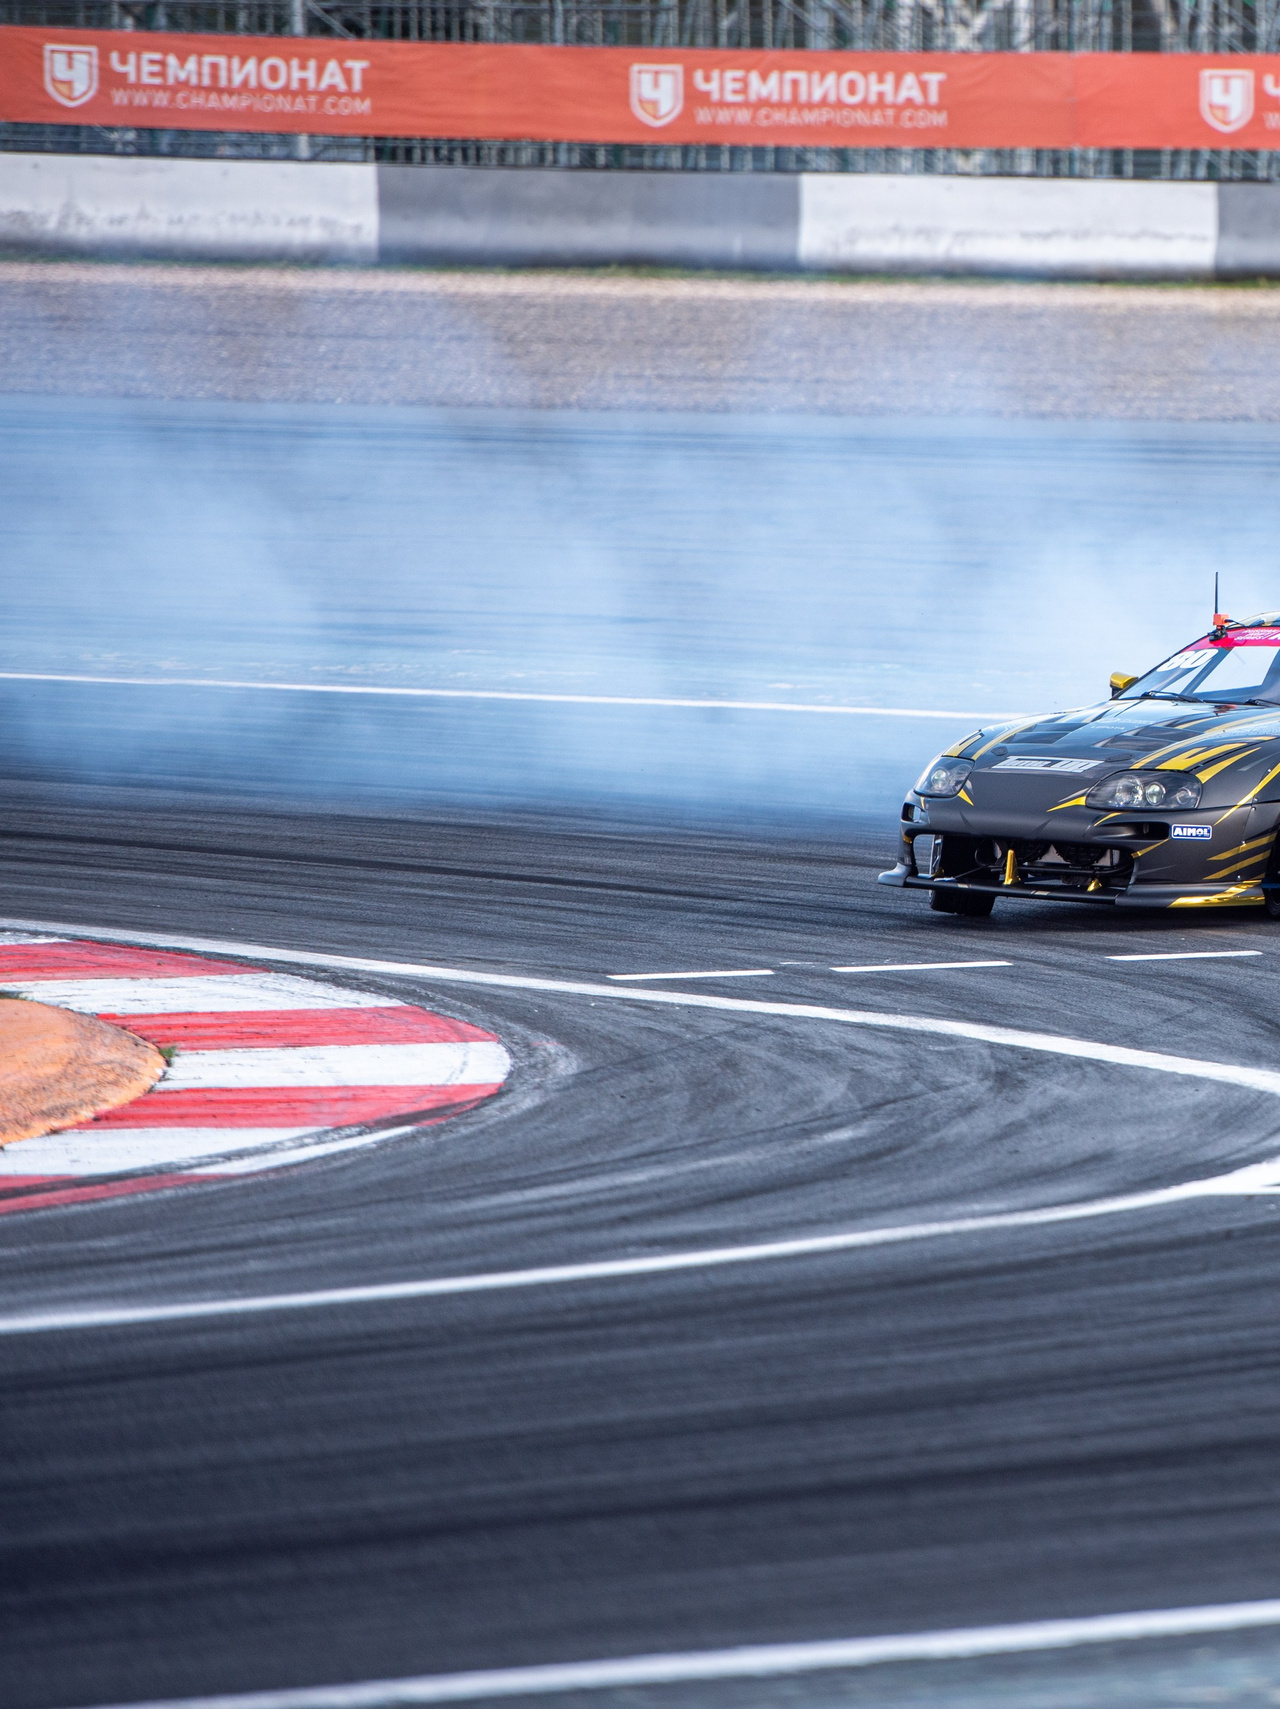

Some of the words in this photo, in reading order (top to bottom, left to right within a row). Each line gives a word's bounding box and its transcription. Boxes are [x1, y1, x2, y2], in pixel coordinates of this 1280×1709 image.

[109, 50, 370, 93] ЧЕМПИОНАТ
[693, 69, 948, 106] ЧЕМПИОНАТ
[1156, 648, 1219, 672] 80
[1173, 827, 1210, 837] AIMOL
